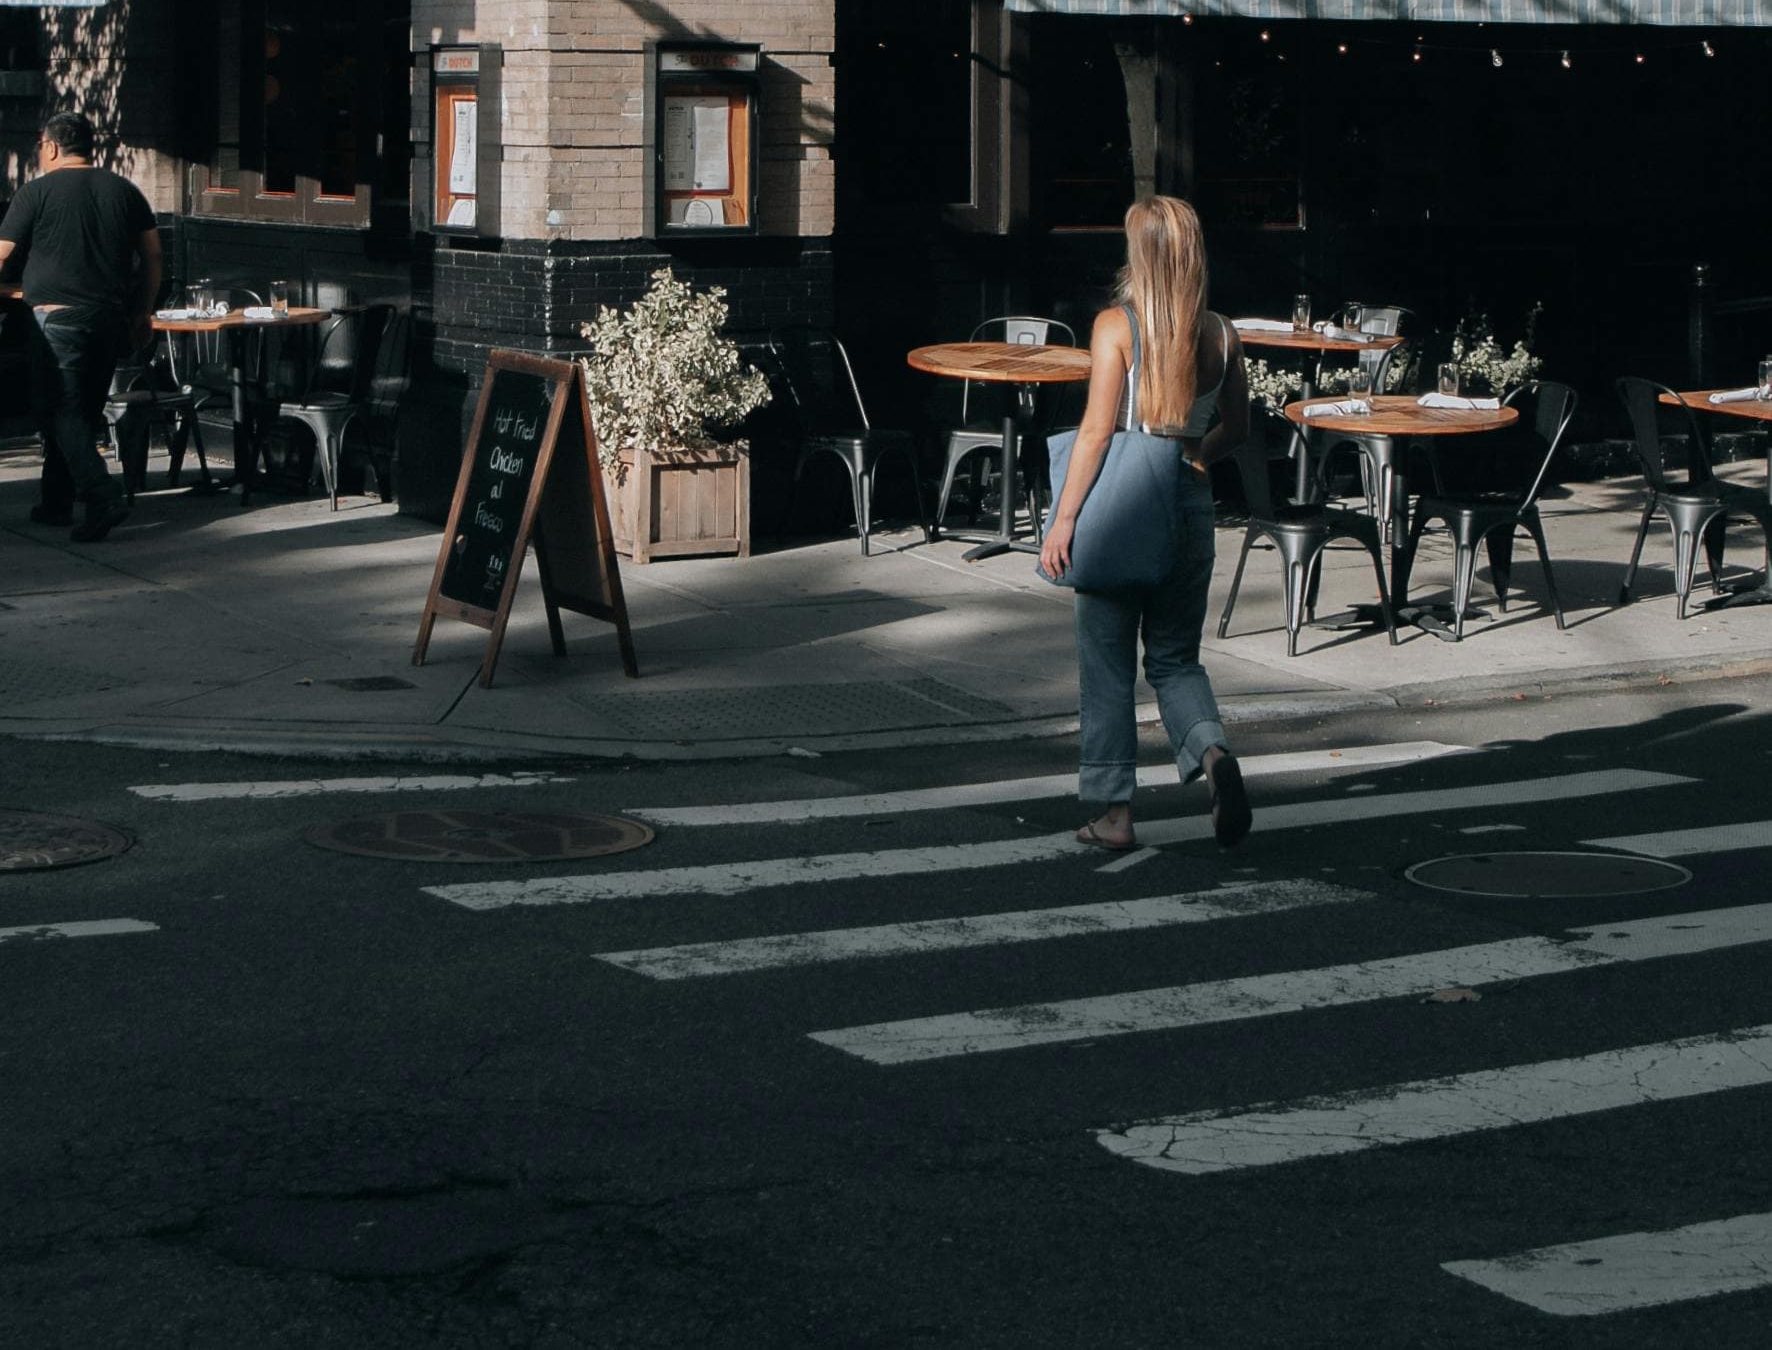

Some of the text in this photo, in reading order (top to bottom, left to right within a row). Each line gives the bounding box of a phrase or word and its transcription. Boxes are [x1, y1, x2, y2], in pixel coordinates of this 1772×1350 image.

[493, 409, 538, 441] Hot Fried
[490, 446, 523, 476] Chicken
[490, 480, 504, 499] al
[475, 501, 503, 533] Fresco
